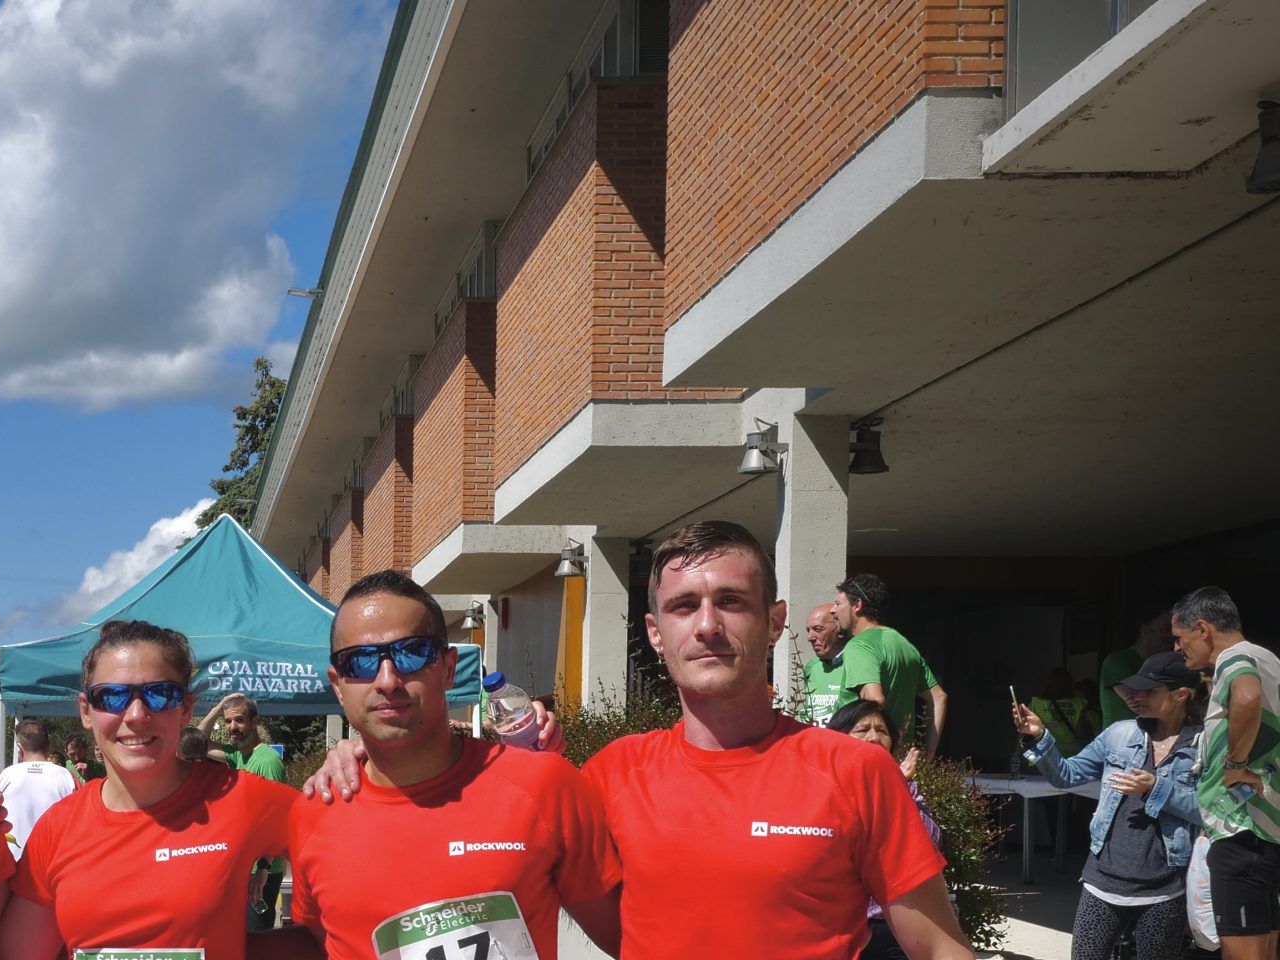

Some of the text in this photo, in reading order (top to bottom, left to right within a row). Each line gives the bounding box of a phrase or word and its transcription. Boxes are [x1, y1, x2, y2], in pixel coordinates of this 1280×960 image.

[207, 661, 318, 677] CAJA RURAL
[207, 677, 326, 693] DE NAVARRA
[769, 825, 833, 837] ROCKWOOL
[172, 842, 228, 857] ROCKWOOL
[466, 842, 526, 851] ROCKWOOL
[400, 901, 485, 932] Schneider
[441, 913, 488, 931] Electric
